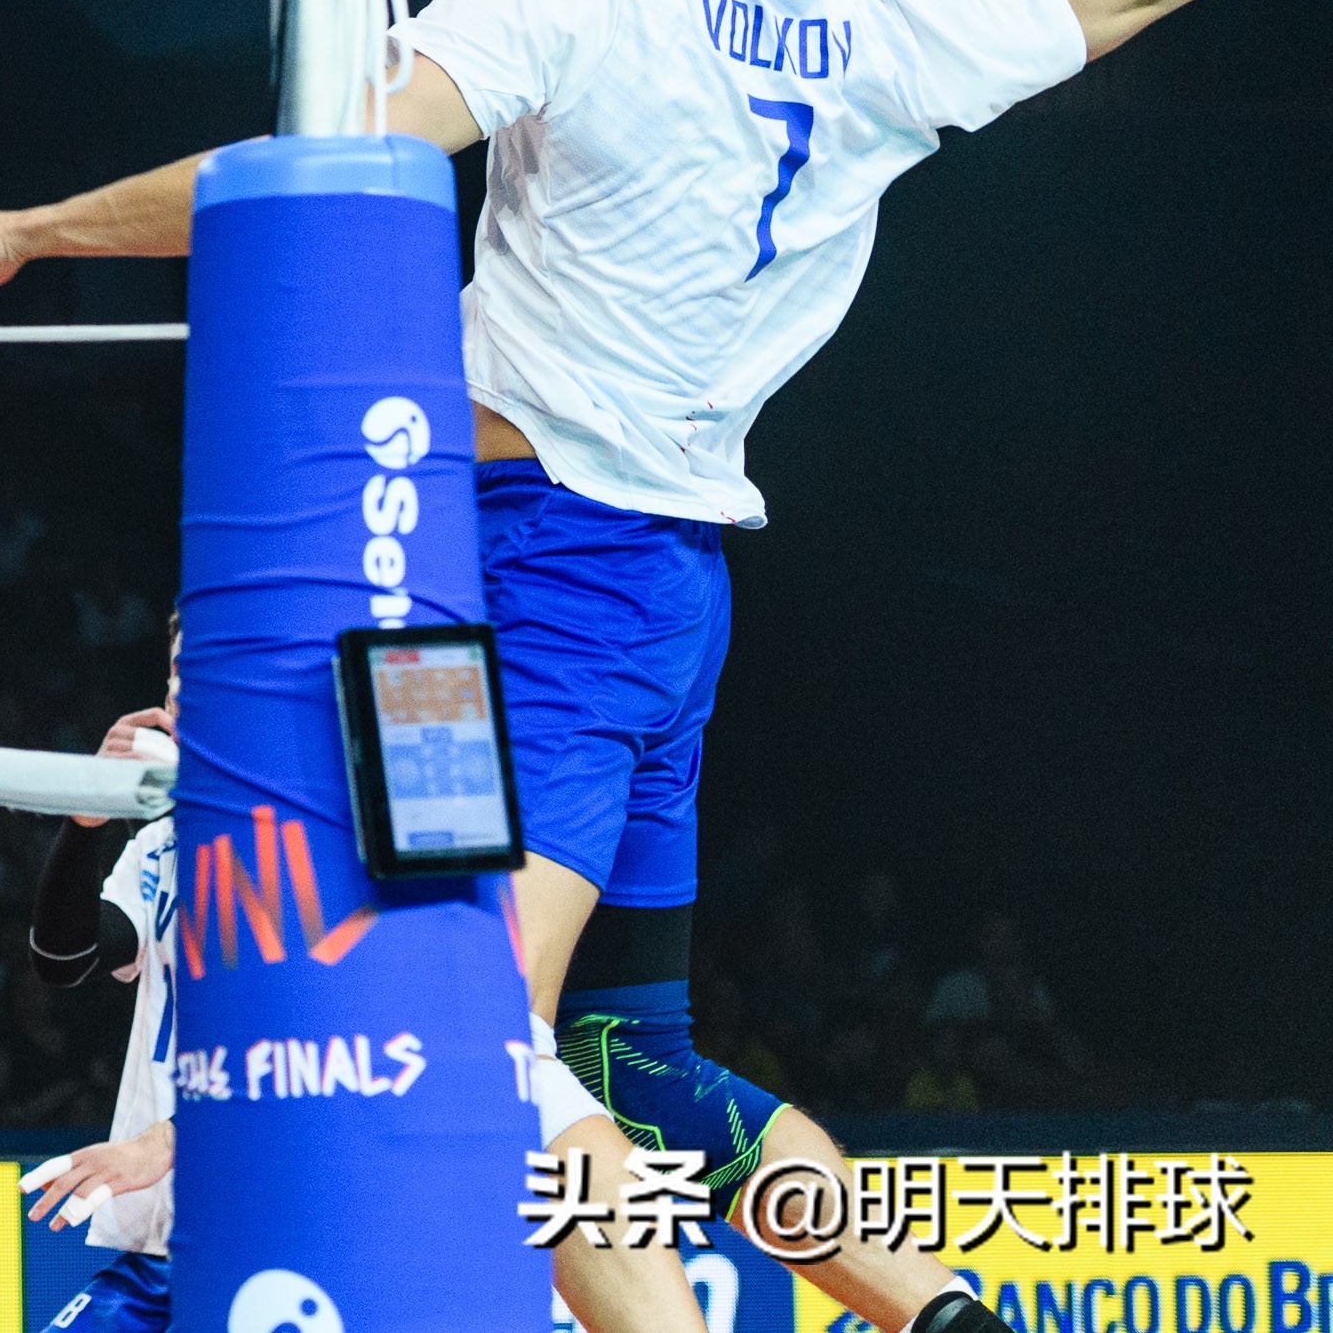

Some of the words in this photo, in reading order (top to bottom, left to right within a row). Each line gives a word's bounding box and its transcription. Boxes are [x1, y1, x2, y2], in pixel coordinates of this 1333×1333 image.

[744, 93, 814, 283] 7
[178, 806, 380, 979] VNL
[245, 1032, 427, 1102] FINALS
[1175, 1274, 1255, 1333] DO
